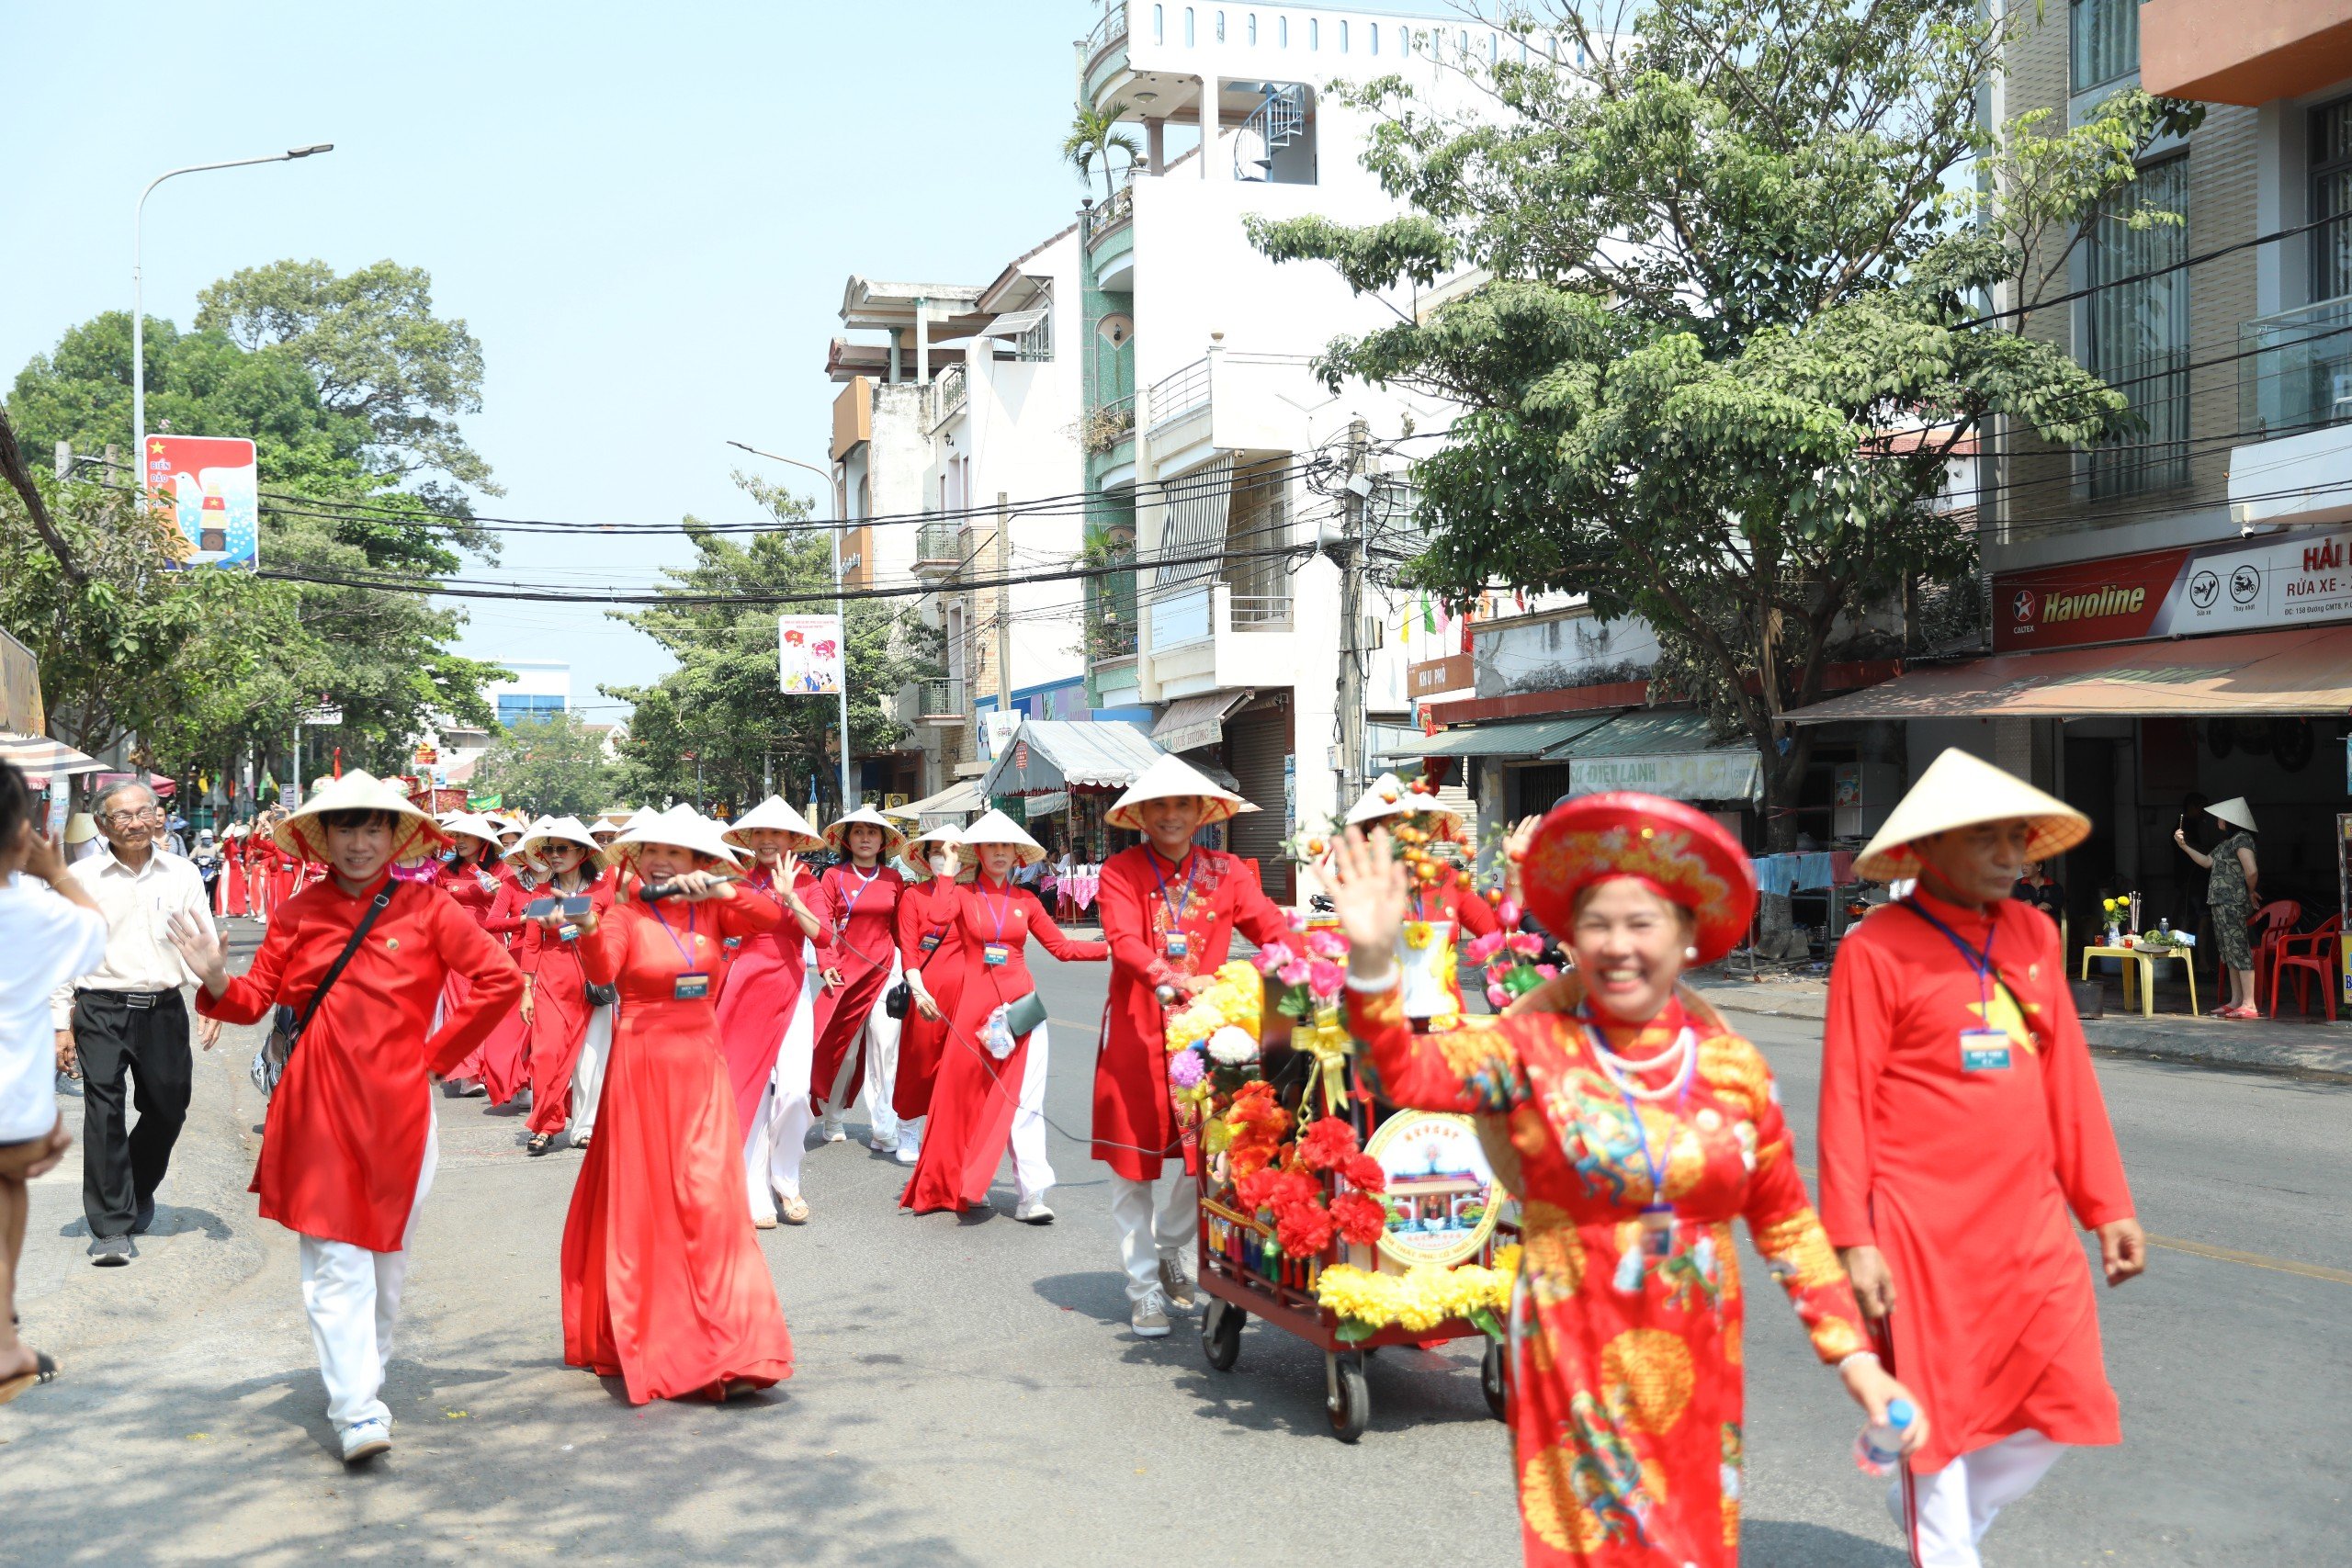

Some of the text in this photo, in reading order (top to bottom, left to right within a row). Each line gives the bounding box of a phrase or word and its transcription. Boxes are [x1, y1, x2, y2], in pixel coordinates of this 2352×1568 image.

[2287, 578, 2315, 597] RỬA
[2319, 578, 2336, 593] XE
[2041, 584, 2145, 624] Havoline
[2013, 625, 2035, 634] CALTEX
